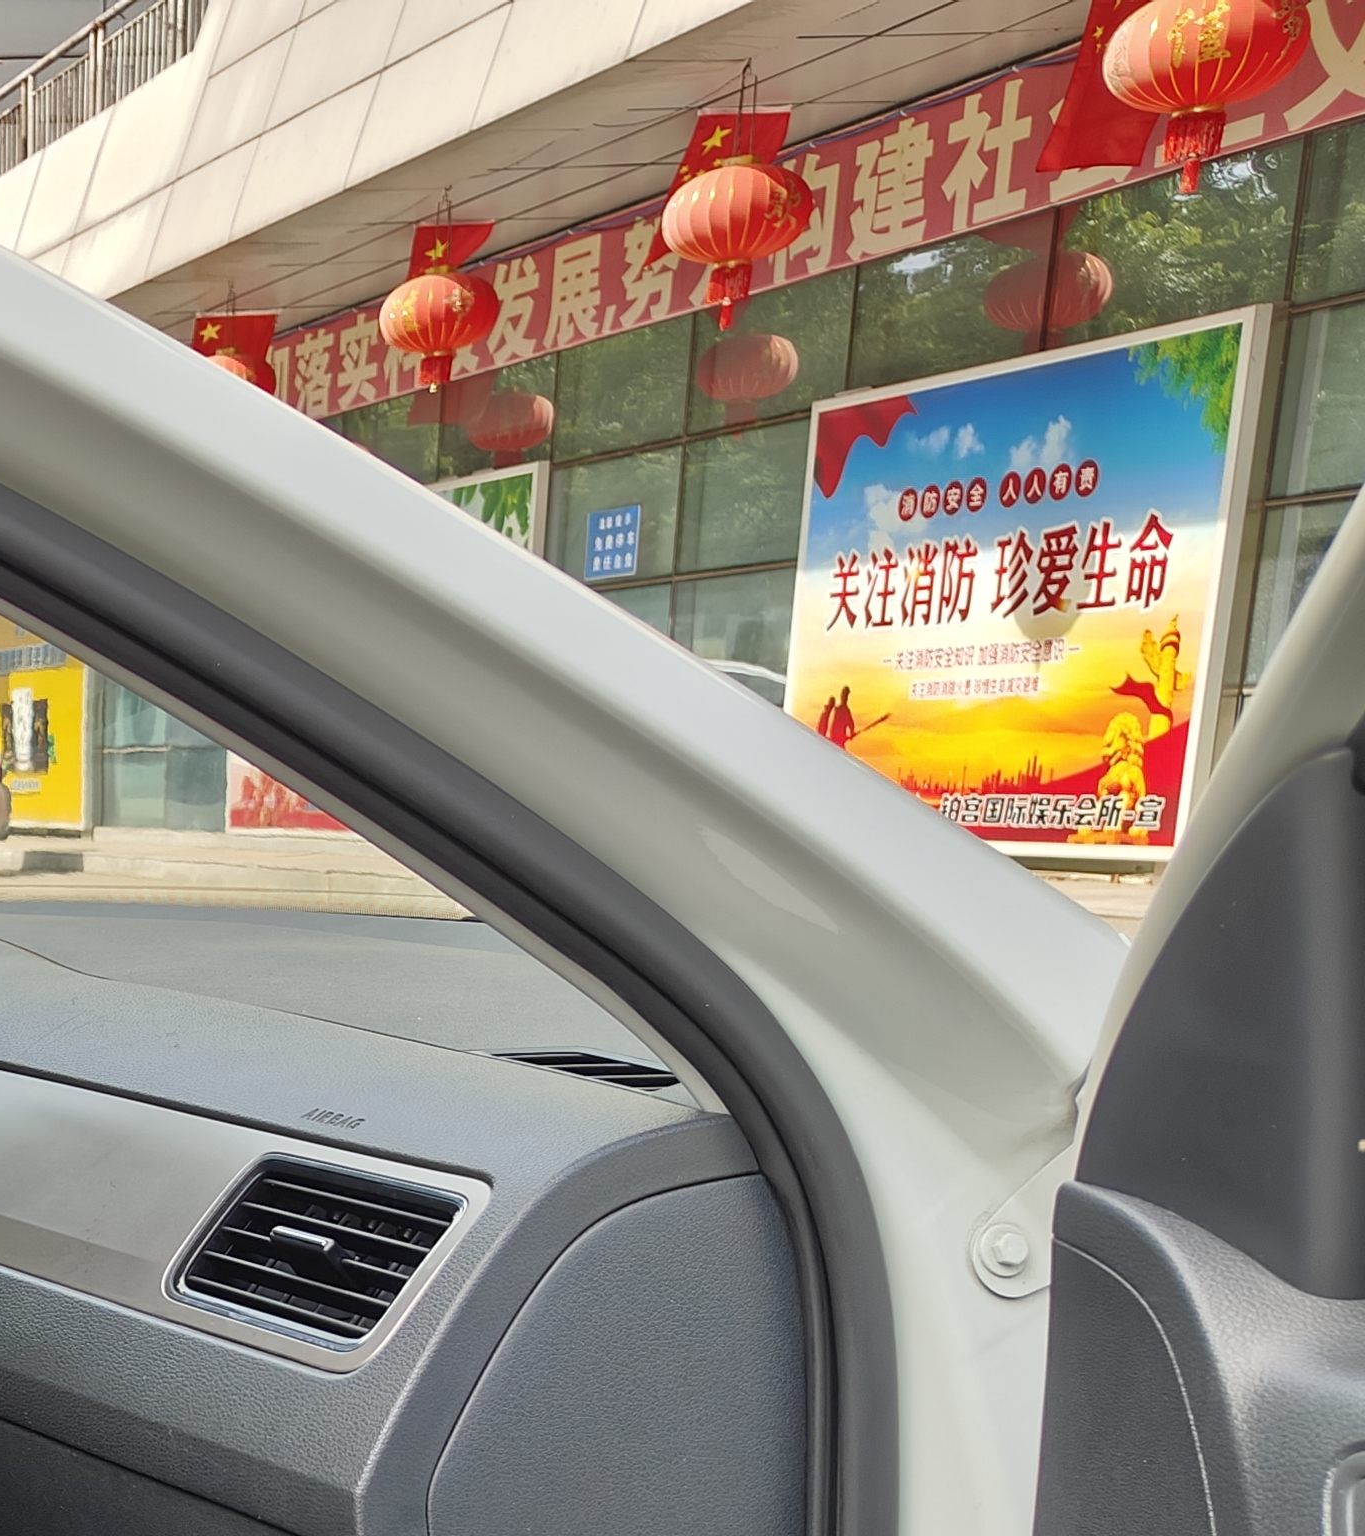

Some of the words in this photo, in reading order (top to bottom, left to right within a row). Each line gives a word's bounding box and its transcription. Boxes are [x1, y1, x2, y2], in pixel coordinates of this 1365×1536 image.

[900, 479, 984, 517] 消防安全
[1002, 463, 1095, 504] 人人有责
[827, 538, 979, 632] 关注消防
[990, 512, 1175, 618] 珍爱生命
[300, 1108, 366, 1129] AIRBAG
